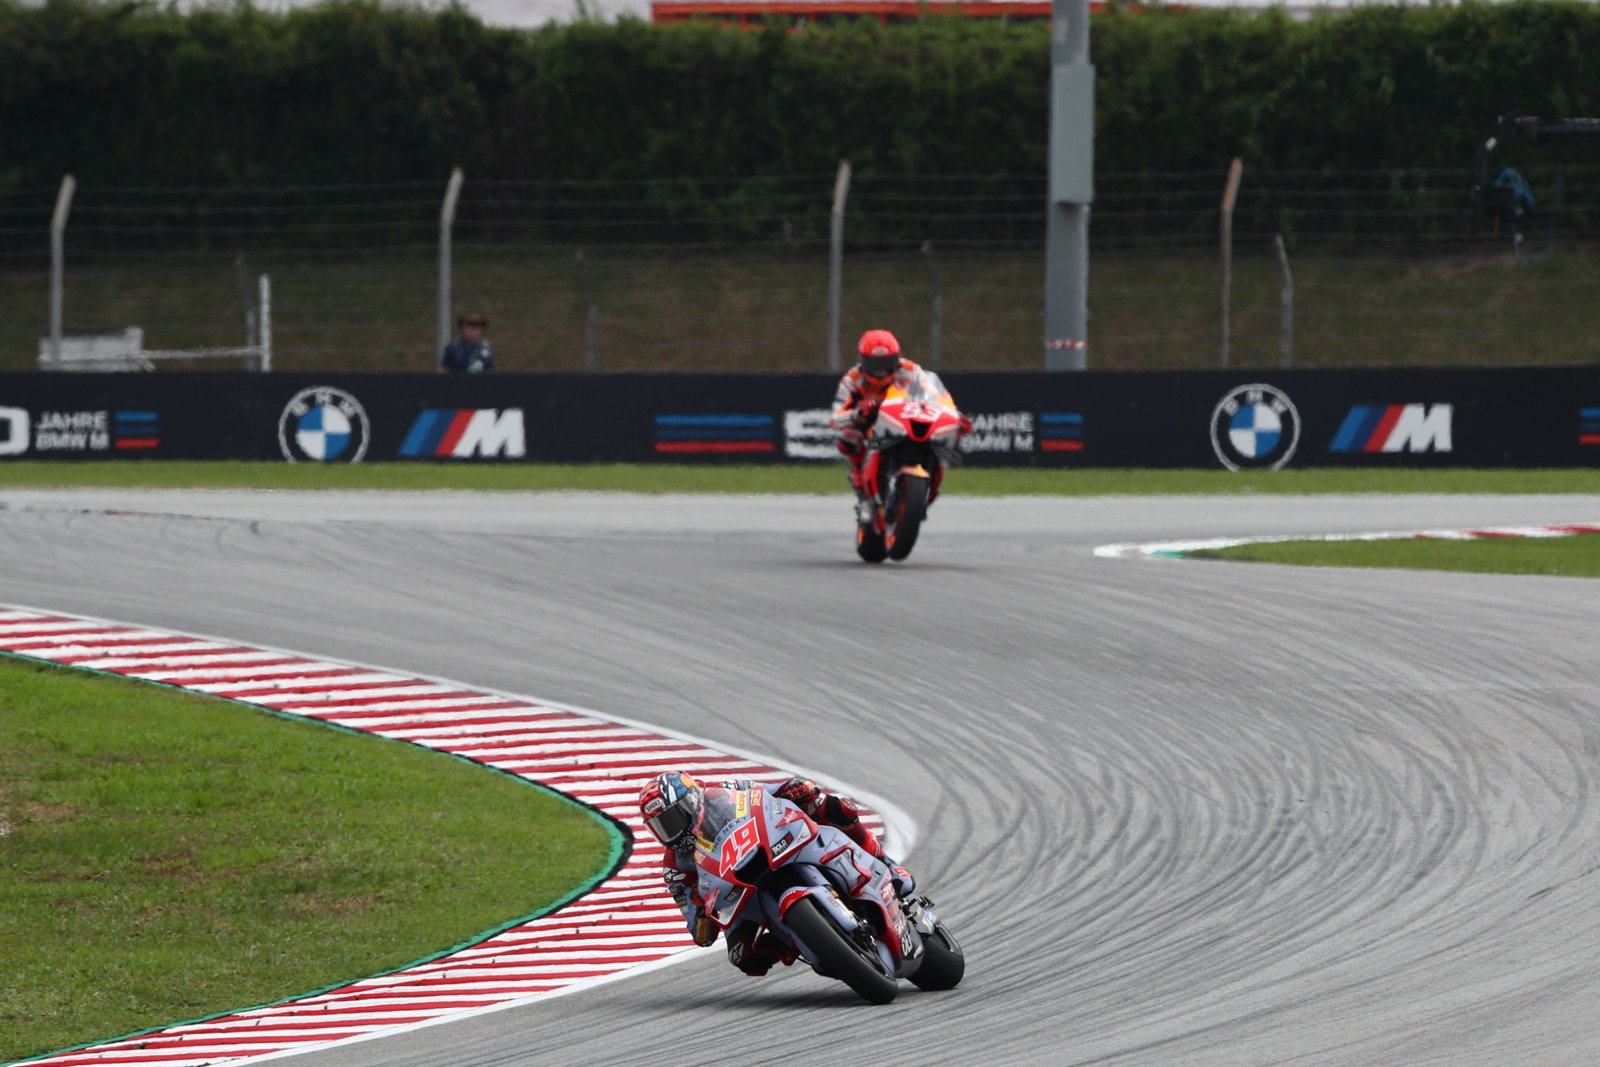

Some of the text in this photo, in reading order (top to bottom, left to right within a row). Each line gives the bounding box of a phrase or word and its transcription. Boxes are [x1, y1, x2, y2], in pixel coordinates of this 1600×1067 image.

[36, 410, 107, 430] JAHRE
[970, 411, 1033, 432] AHRE
[1381, 403, 1453, 453] M
[35, 431, 109, 450] BMW M
[452, 408, 525, 457] M
[1014, 433, 1033, 451] M
[719, 816, 760, 878] 49
